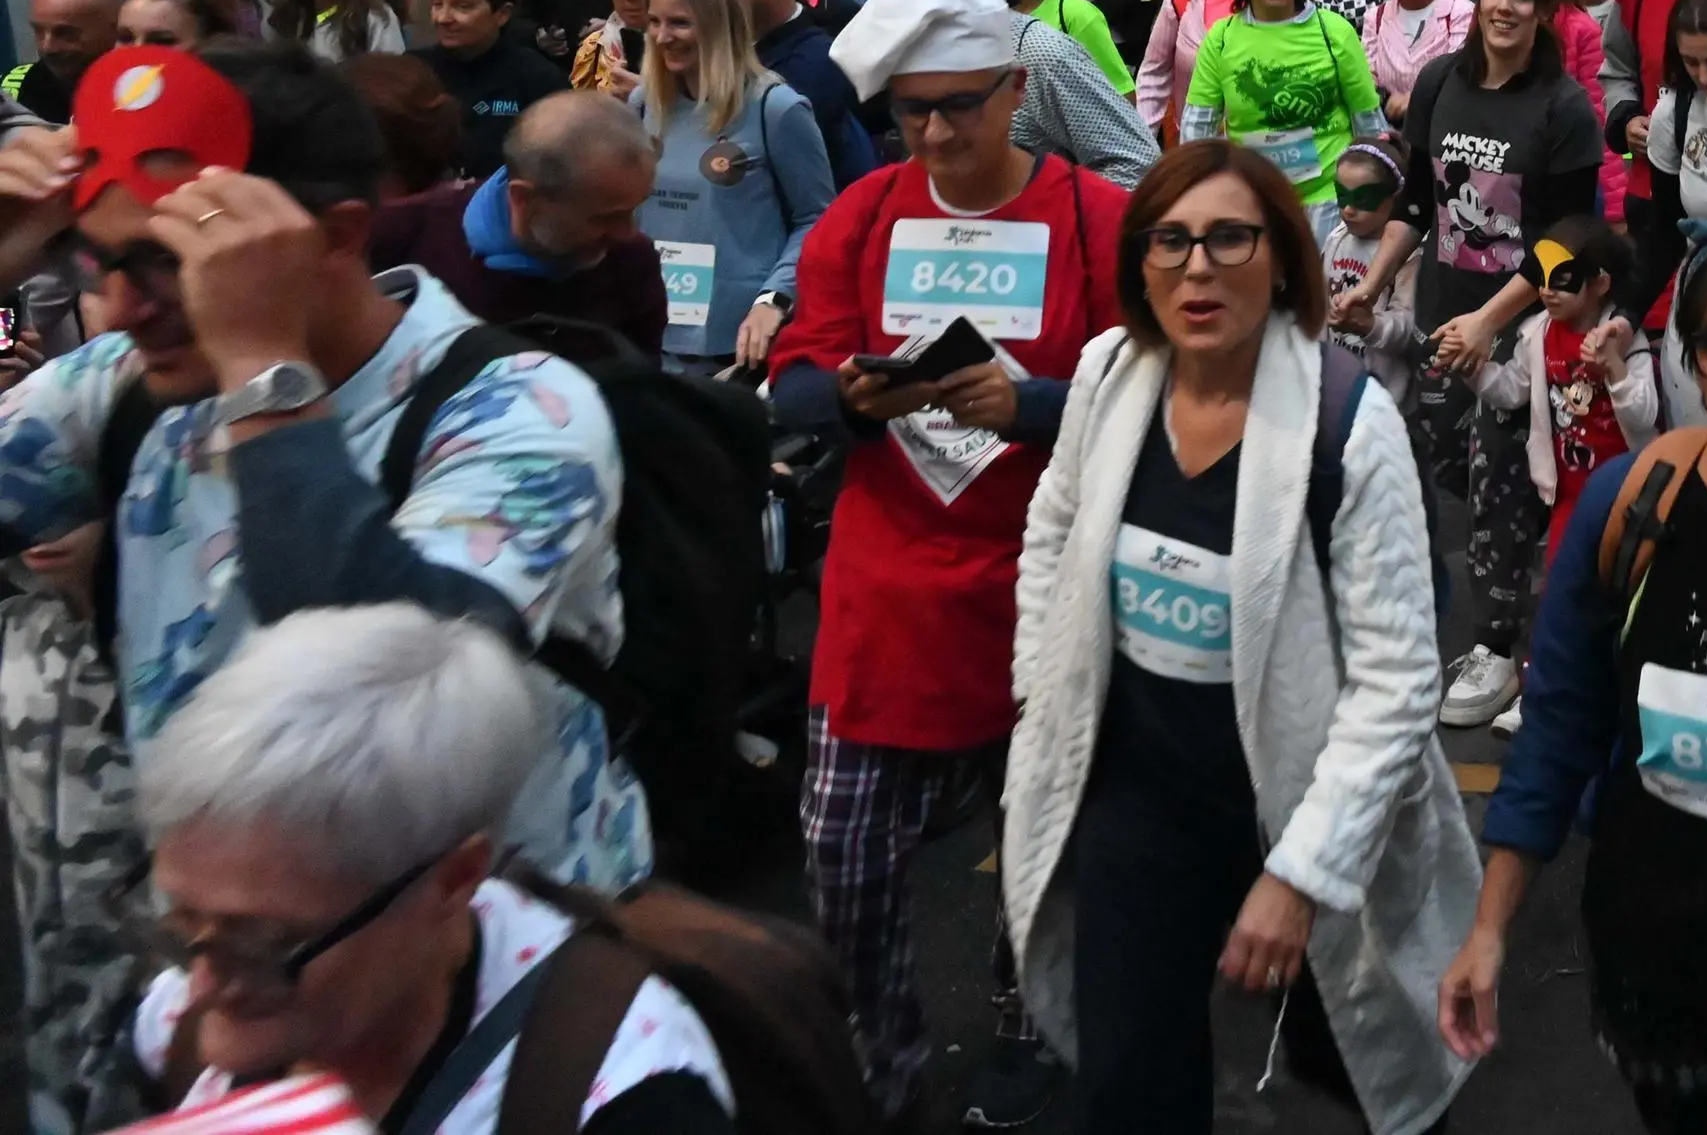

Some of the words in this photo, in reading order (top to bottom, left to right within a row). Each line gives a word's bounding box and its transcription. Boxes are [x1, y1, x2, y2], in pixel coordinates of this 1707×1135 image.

[492, 99, 519, 113] IRMA
[1441, 131, 1512, 158] MICKEY
[1440, 148, 1505, 175] MOUSE
[911, 260, 1018, 295] 8420
